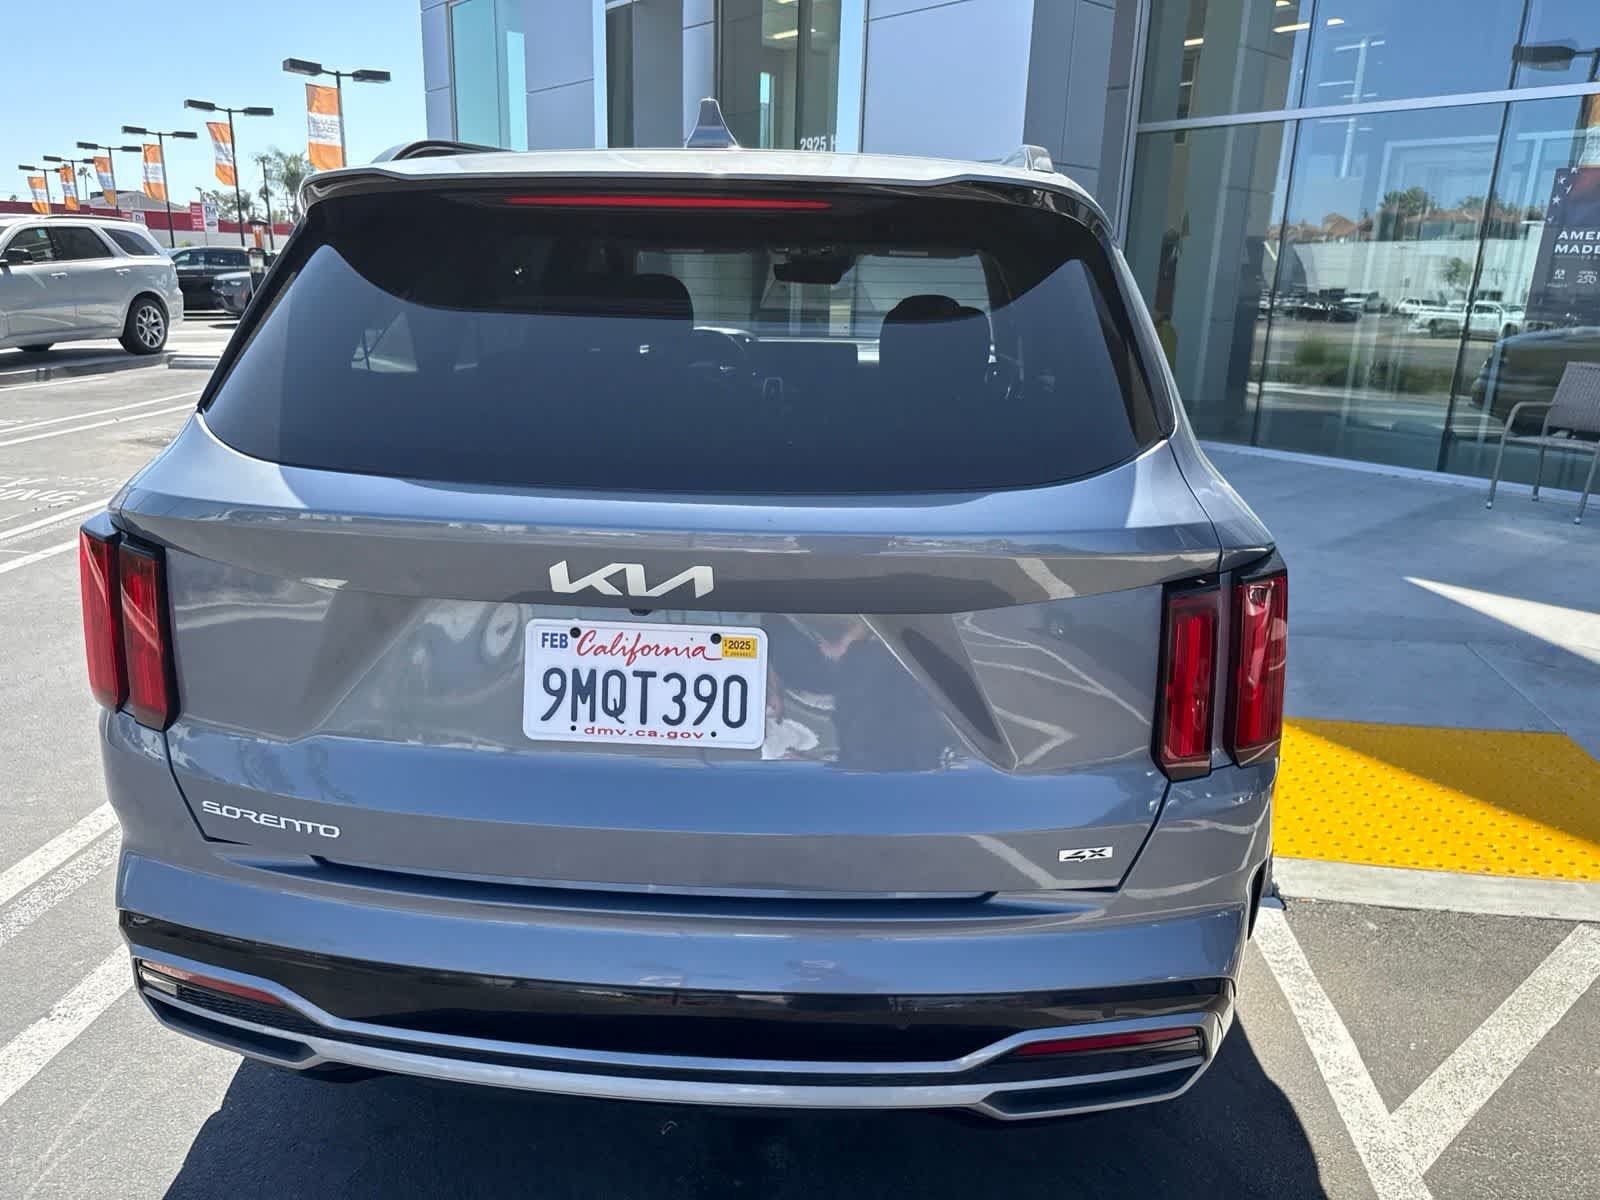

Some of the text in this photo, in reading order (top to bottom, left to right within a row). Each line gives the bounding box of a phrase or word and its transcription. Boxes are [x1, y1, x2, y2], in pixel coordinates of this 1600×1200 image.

[800, 136, 826, 152] 2925
[1554, 244, 1600, 254] MADE
[549, 560, 714, 598] KIA
[541, 632, 569, 649] FEB
[577, 630, 722, 667] California
[728, 640, 751, 650] 2025
[540, 667, 748, 729] 9MQT390
[583, 726, 704, 740] dmv.ca.gov
[202, 800, 341, 838] SORENTO
